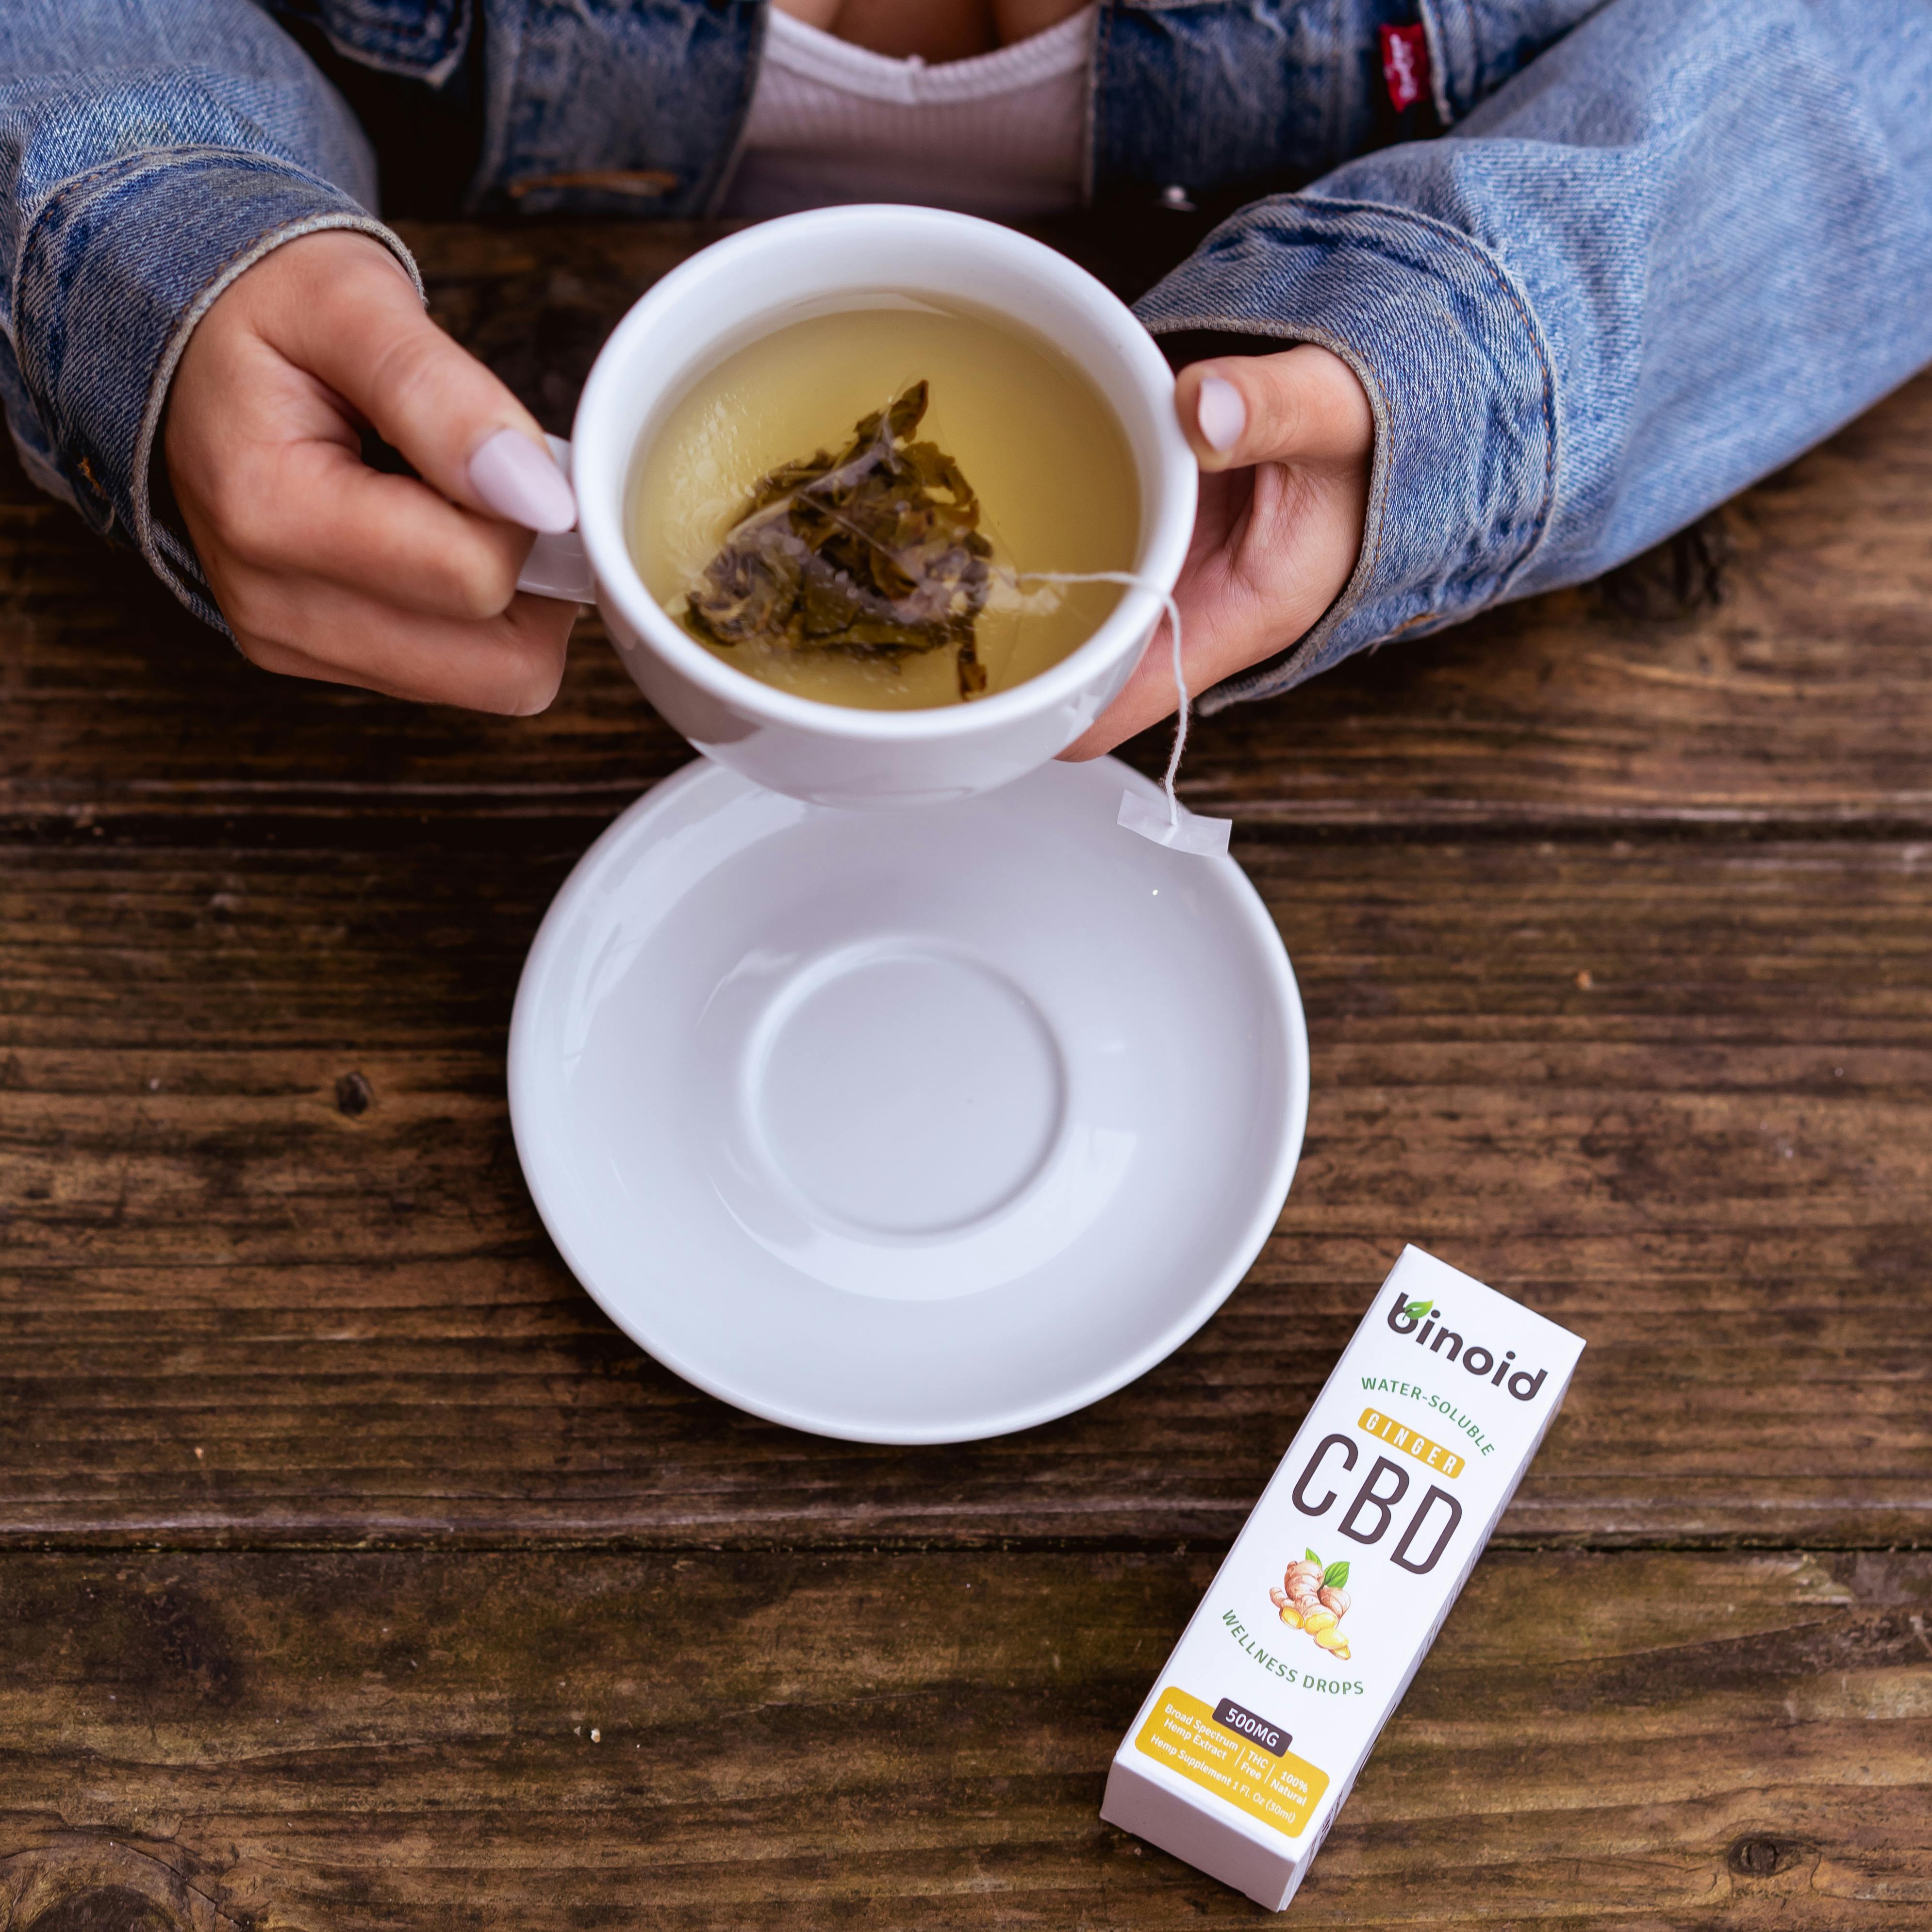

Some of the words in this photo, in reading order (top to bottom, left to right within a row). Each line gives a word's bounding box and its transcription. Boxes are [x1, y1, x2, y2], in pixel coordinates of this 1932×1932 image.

[1387, 1292, 1548, 1401] binoid
[1361, 1377, 1495, 1456] WATER-SOLUBLE
[1366, 1413, 1457, 1474] GINGER
[1292, 1433, 1462, 1574] CBD
[1222, 1609, 1298, 1683] WELLNESS
[1303, 1675, 1364, 1695] DROPS
[1164, 1718, 1191, 1740] Hemp
[1193, 1734, 1227, 1760] Extract
[1165, 1703, 1192, 1725] Broad
[1193, 1719, 1239, 1751] Spectrum
[1225, 1707, 1280, 1747] 500MG
[1151, 1734, 1176, 1756] Hemp
[1178, 1750, 1232, 1786] Supplement
[1232, 1781, 1238, 1791] 1
[1239, 1785, 1250, 1799] Fl.
[1253, 1793, 1265, 1806] Oz
[1265, 1799, 1296, 1824] (30ml)
[1240, 1762, 1261, 1780] Free
[1248, 1750, 1268, 1769] THC
[1280, 1771, 1308, 1793] 100%
[1271, 1780, 1307, 1806] Natural
